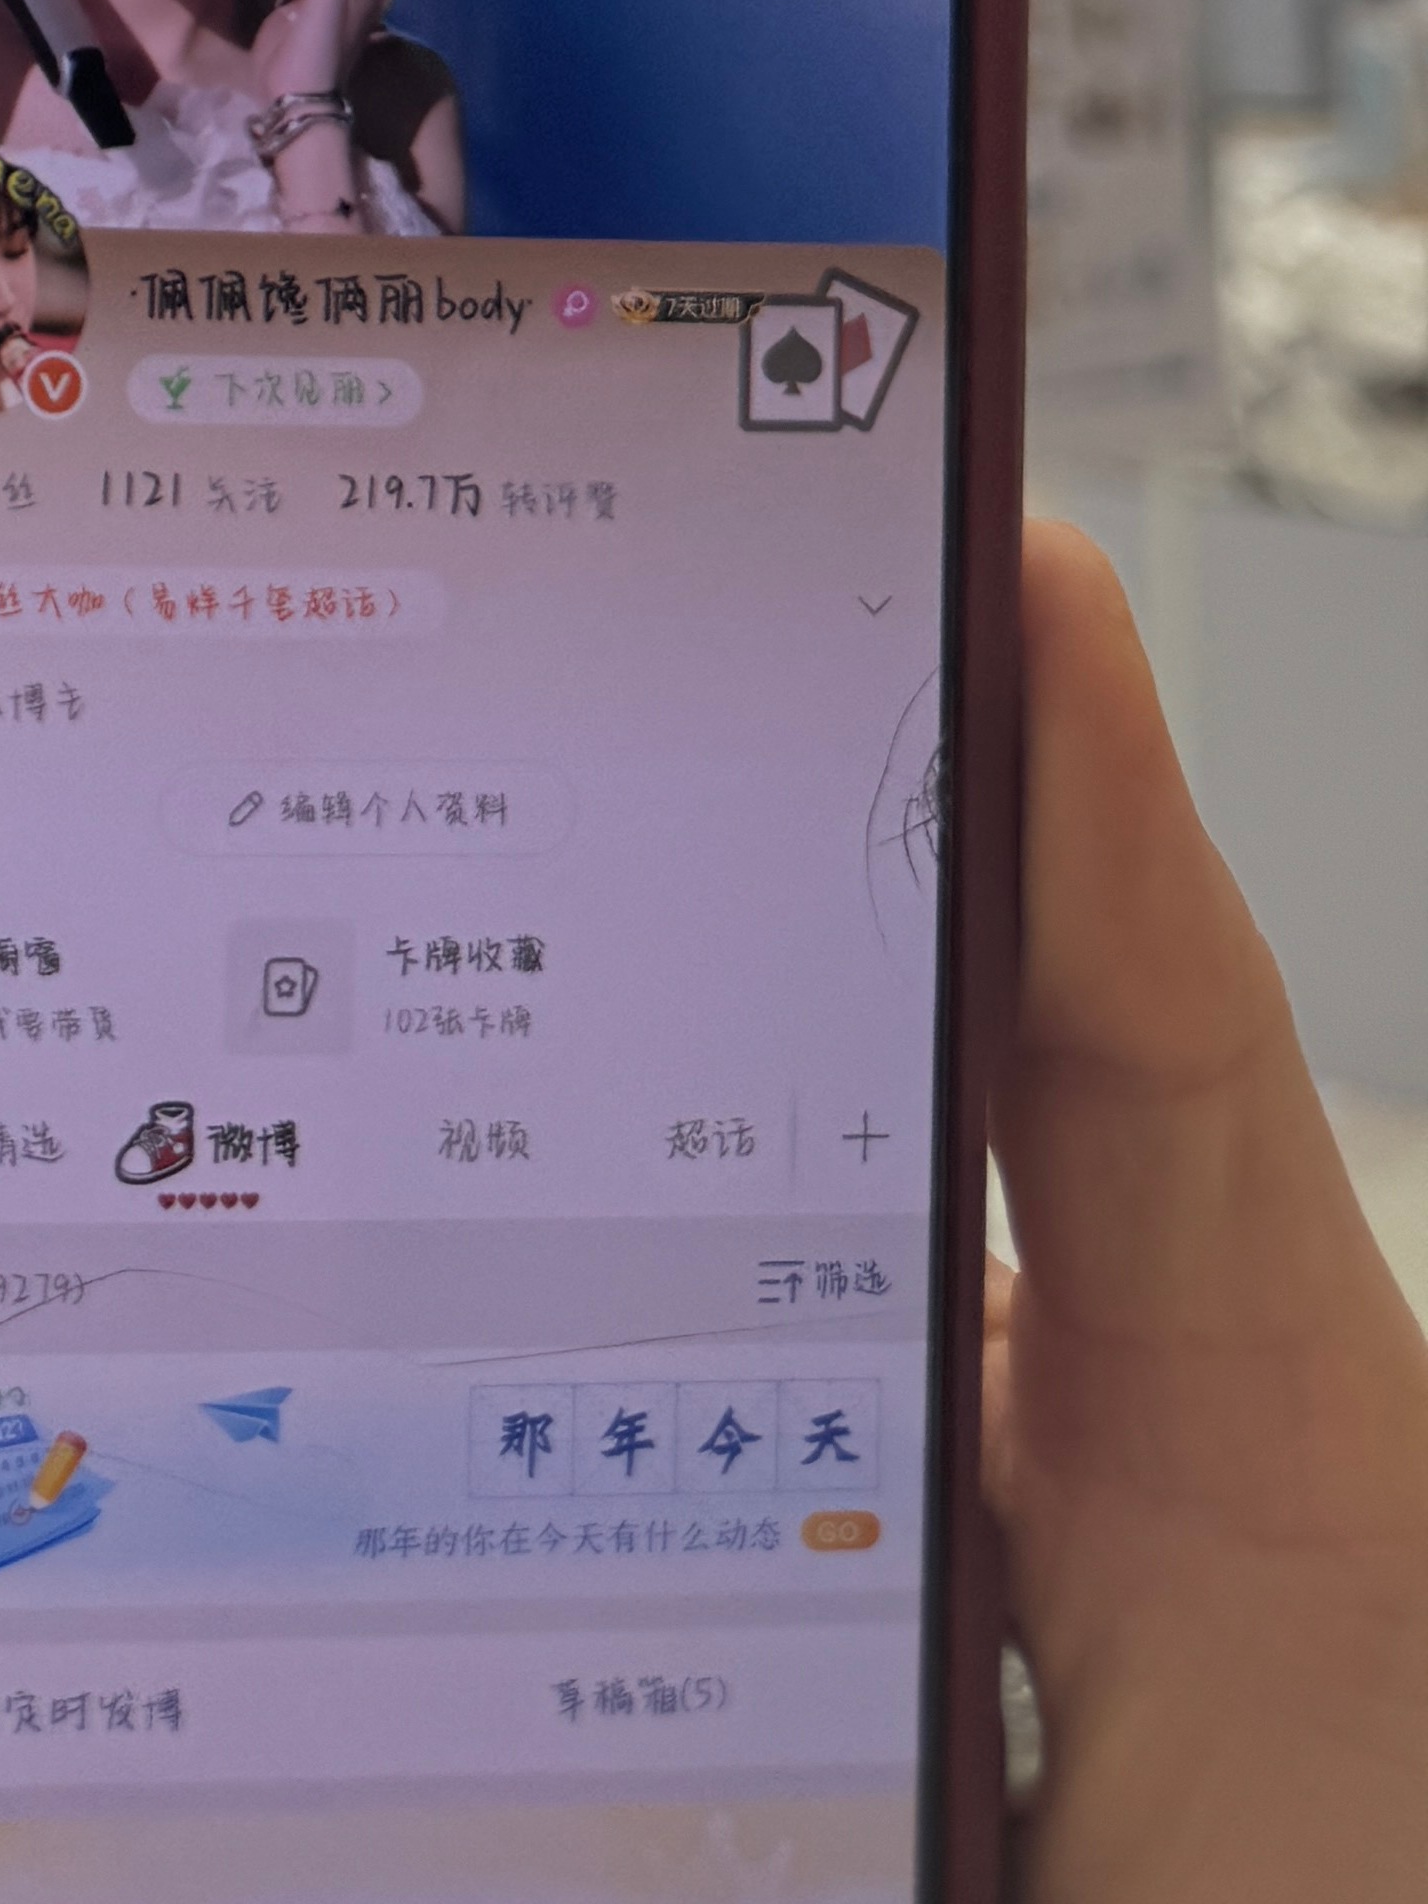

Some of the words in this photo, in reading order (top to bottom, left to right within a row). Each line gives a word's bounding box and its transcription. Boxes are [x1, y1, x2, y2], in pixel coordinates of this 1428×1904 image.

[101, 469, 182, 507] 1121
[205, 475, 281, 514] 关注
[338, 473, 484, 517] 219.7万
[280, 790, 508, 827] 编辑个人资料
[385, 935, 545, 977] 卡牌收藏
[384, 1004, 533, 1039] 102张卡牌
[206, 1119, 301, 1168] 微博
[438, 1117, 531, 1163] 视频
[664, 1116, 756, 1160] 超话
[815, 1259, 893, 1301] 筛选
[498, 1404, 860, 1479] 那年今天
[354, 1515, 781, 1560] 那年的你在今天有什么动态
[817, 1520, 861, 1546] GO
[550, 1676, 727, 1724] 草稿箱(5)
